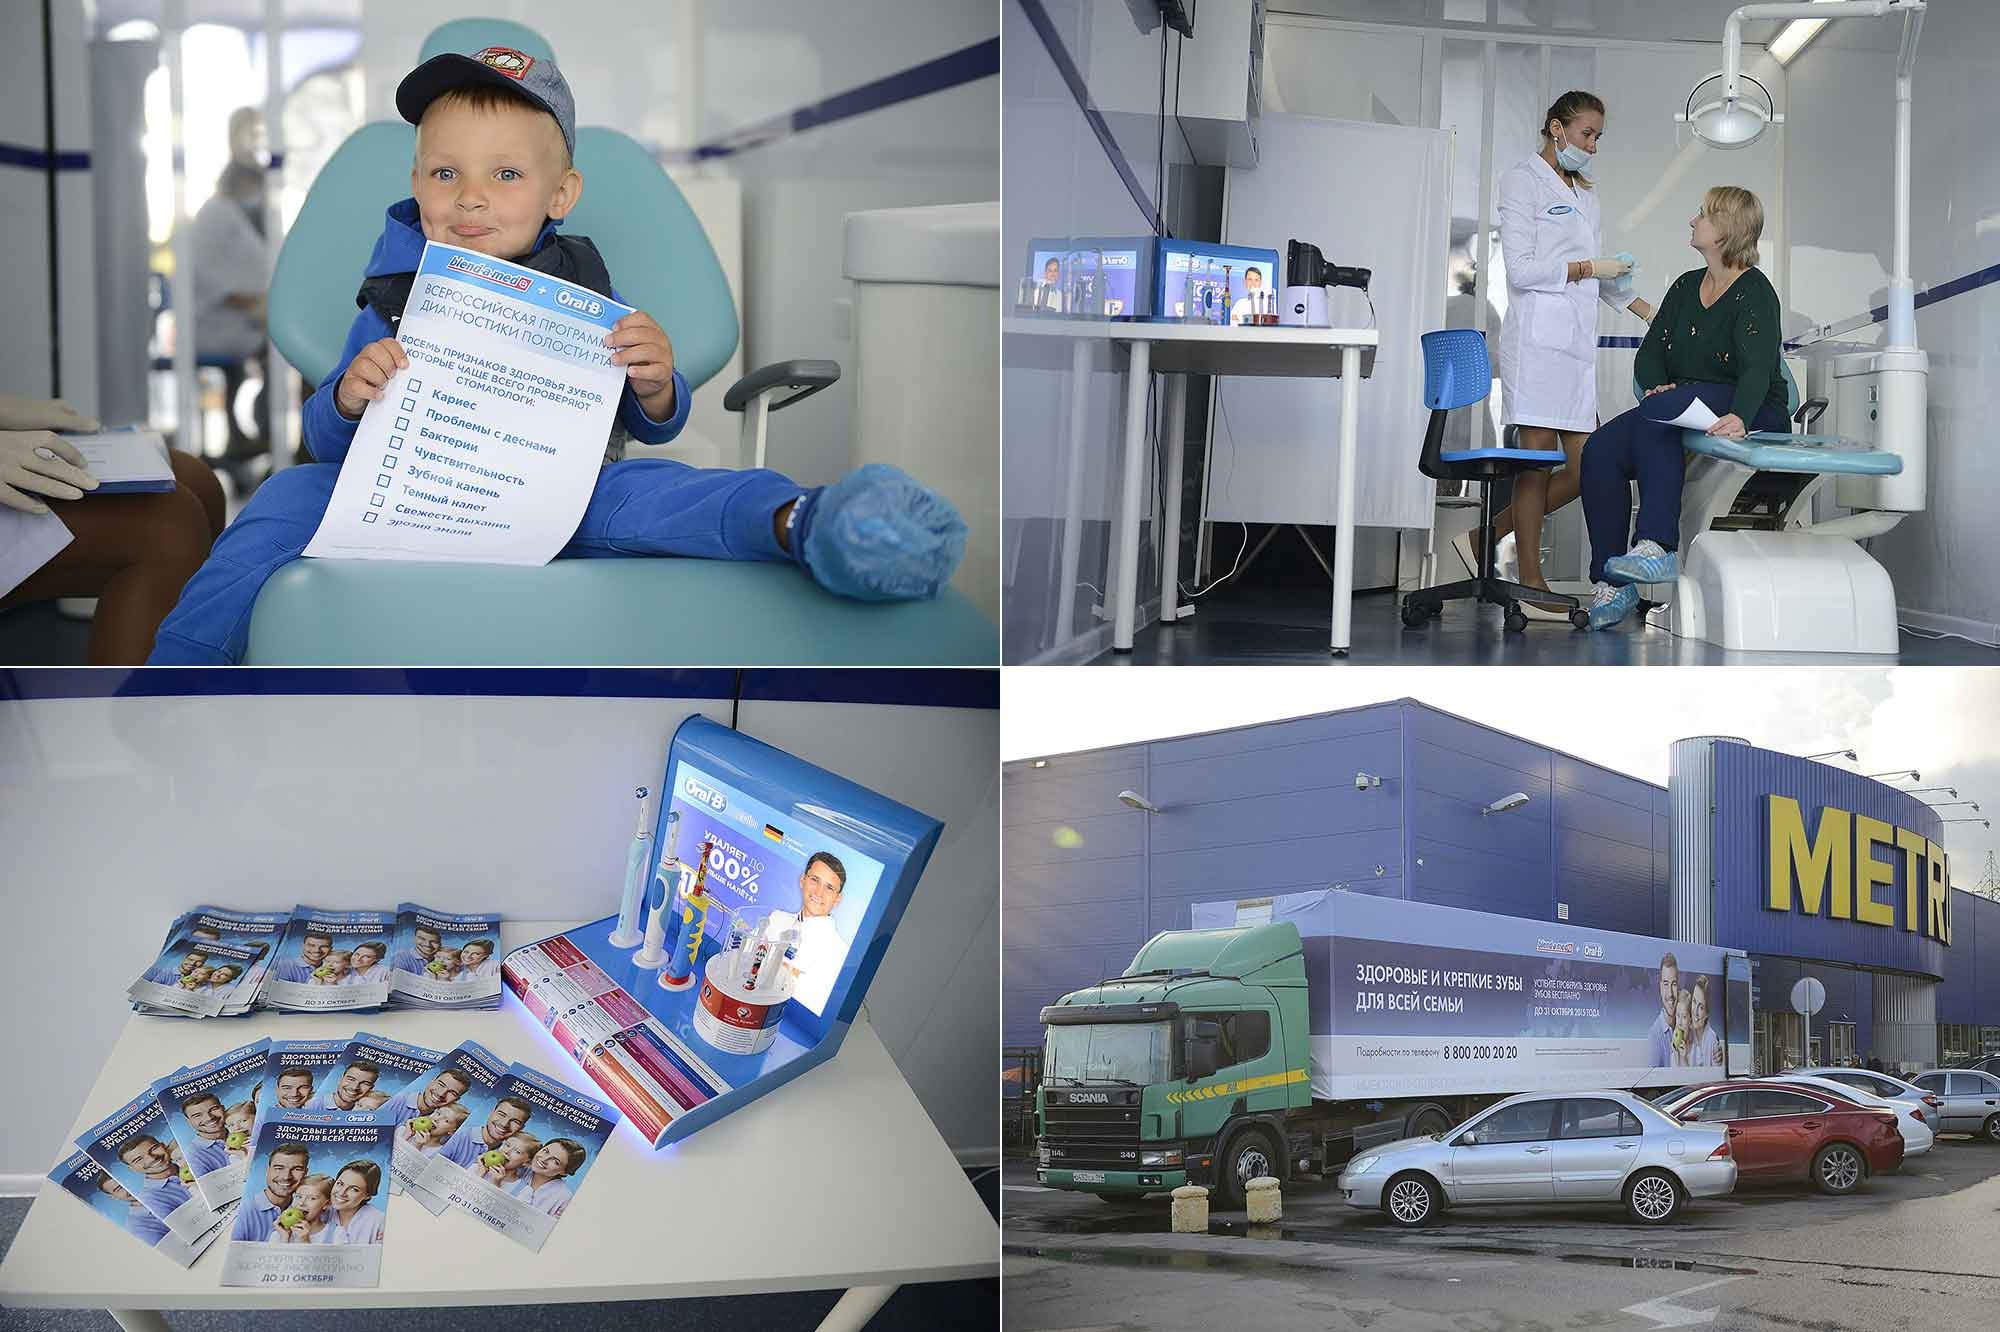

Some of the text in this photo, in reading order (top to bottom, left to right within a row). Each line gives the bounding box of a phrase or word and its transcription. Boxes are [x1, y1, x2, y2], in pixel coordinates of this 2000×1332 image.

[424, 283, 536, 326] ВСЕРОССИЙСКАЯ
[557, 290, 602, 315] Oral-B
[419, 300, 612, 369] ДИАГНОСТИКИ ПОЛОСТИ РТА
[401, 334, 441, 354] ВОСЕМЬ
[443, 347, 507, 374] ПРИЗНАКОВ
[509, 368, 565, 392] ЗДОРОВЬЯ
[406, 349, 454, 370] КОТОРЫЕ
[491, 374, 525, 392] ВСЕГО
[526, 385, 591, 412] ПРОВЕРЯЮТ
[455, 375, 536, 407] СТОМАТОЛОГИ:
[432, 389, 477, 411] Кариес
[420, 427, 479, 453] Бактерии
[426, 408, 557, 456] Проблемы с деснами
[414, 446, 525, 486] Чувствительность
[407, 465, 501, 499] Зубной камень
[401, 484, 488, 513] Темный налет
[395, 503, 511, 530] Свежесть дыхания
[434, 526, 472, 537] эмали
[685, 779, 726, 810] Oral-B
[704, 830, 765, 873] УДАЛЯЕТ ДО
[708, 848, 760, 894] 00%
[1356, 963, 1523, 992] ЗДОРОВЫЕ И КРЕПКИЕ ЗУБЫ
[1356, 990, 1464, 1013] ДЛЯ ВСЕЙ СЕМЬИ
[355, 1050, 376, 1063] ЗУБЫ
[358, 1045, 402, 1063] ЗДОРОВЫЕ
[1357, 1046, 1401, 1060] Подробности
[1444, 1046, 1518, 1059] 8 800 200 20 20
[172, 1072, 220, 1094] ЗДОРОВЫЕ
[509, 1085, 597, 1131] ЗУБЫ ДЛЯ ВСЕЙ СЕМЬИ
[513, 1080, 557, 1105] ЗДОРОВЫЕ
[563, 1104, 600, 1126] КРЕПКИЕ
[1069, 1093, 1109, 1104] SCANIA
[99, 1112, 146, 1147] ЗДОРОВЫЕ
[275, 1132, 299, 1141] ЗУБЫ
[301, 1134, 320, 1142] ДЛЯ
[322, 1133, 345, 1142] ВСЕЙ
[276, 1125, 327, 1136] ЗДОРОВЫЕ
[338, 1128, 378, 1136] КРЕПКИЕ
[1120, 1151, 1136, 1159] 340
[75, 1161, 96, 1179] ЗДО
[81, 1164, 100, 1182] ЗУБ
[448, 1193, 506, 1229] ДО 31 ОКТЯБРЯ
[261, 1273, 334, 1283] ДО 31 ОКТЯБРЯ
